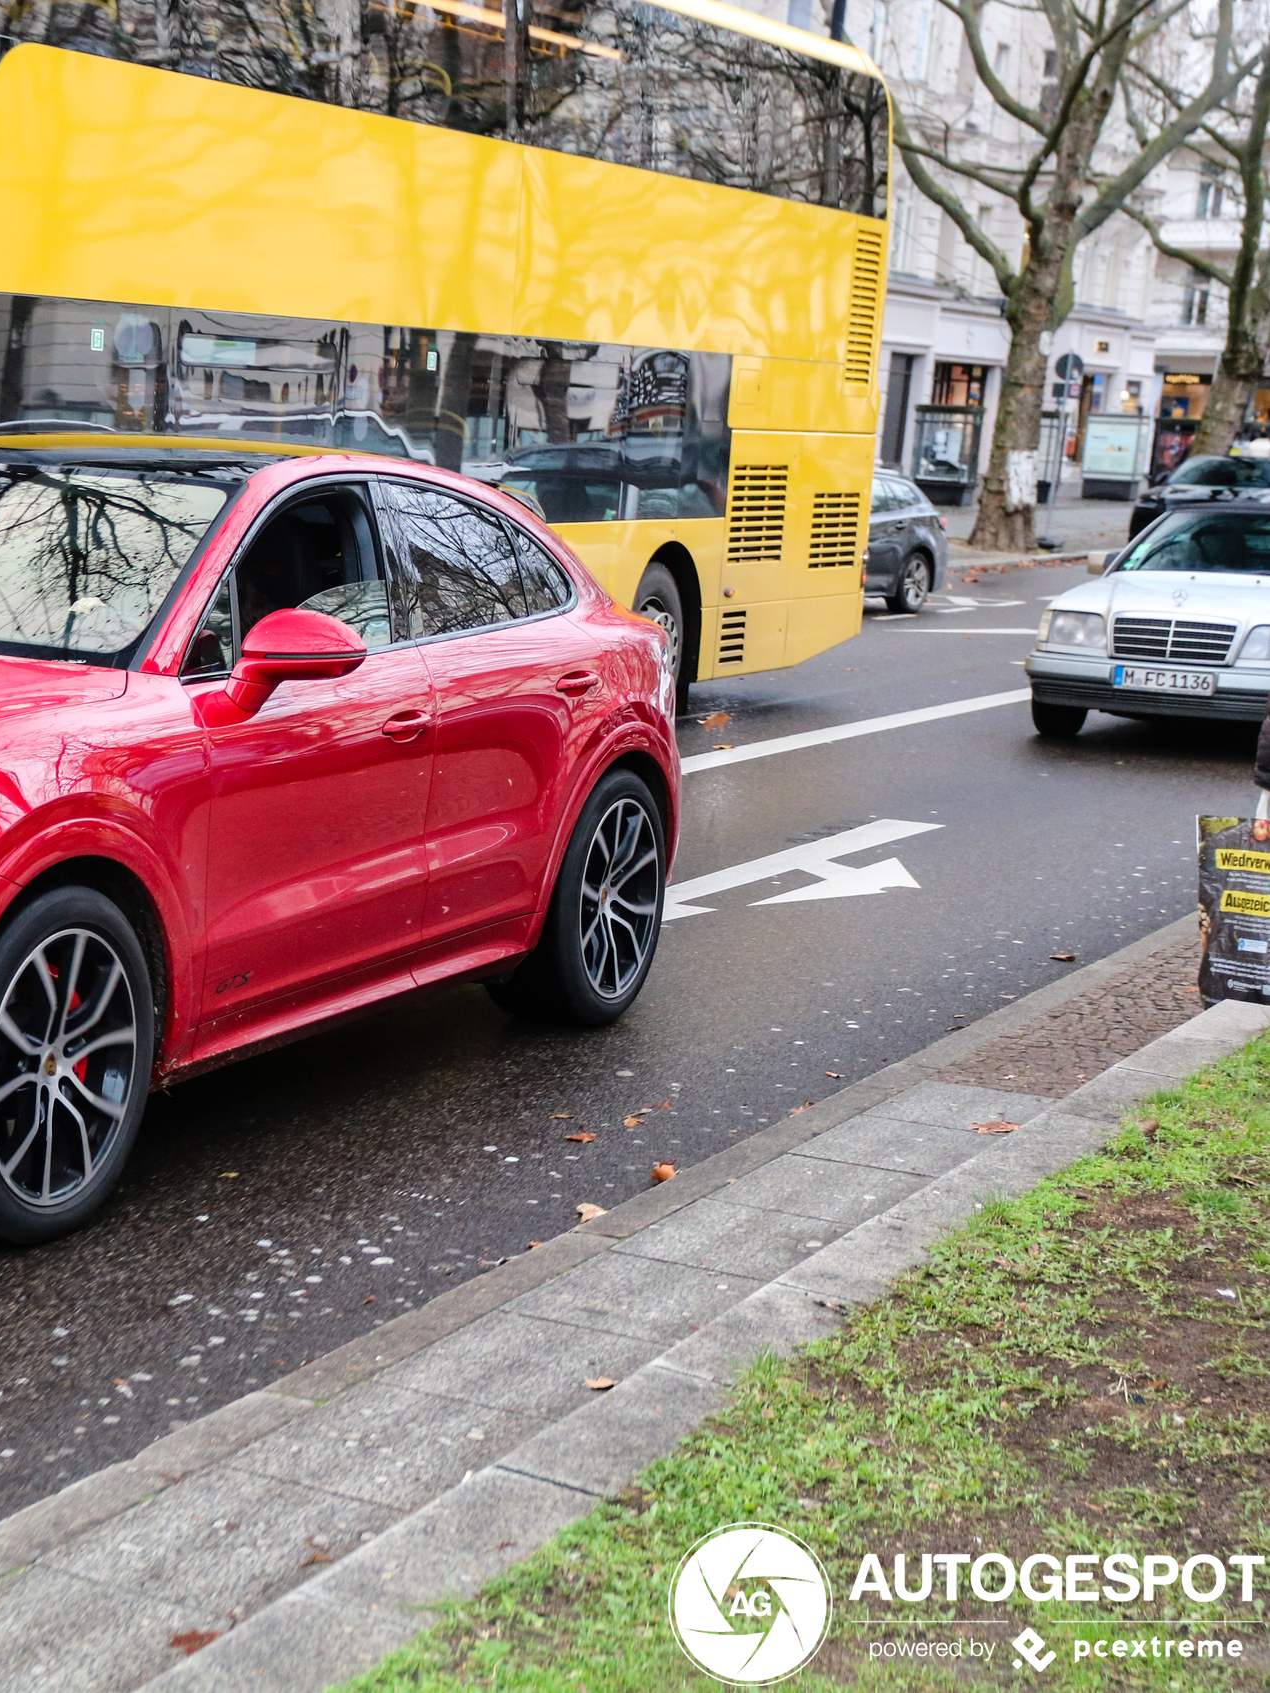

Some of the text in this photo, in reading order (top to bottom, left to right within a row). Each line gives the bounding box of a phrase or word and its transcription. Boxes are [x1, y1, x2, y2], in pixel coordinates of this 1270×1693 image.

[1124, 670, 1210, 691] M FC 1136
[215, 970, 251, 994] GTS
